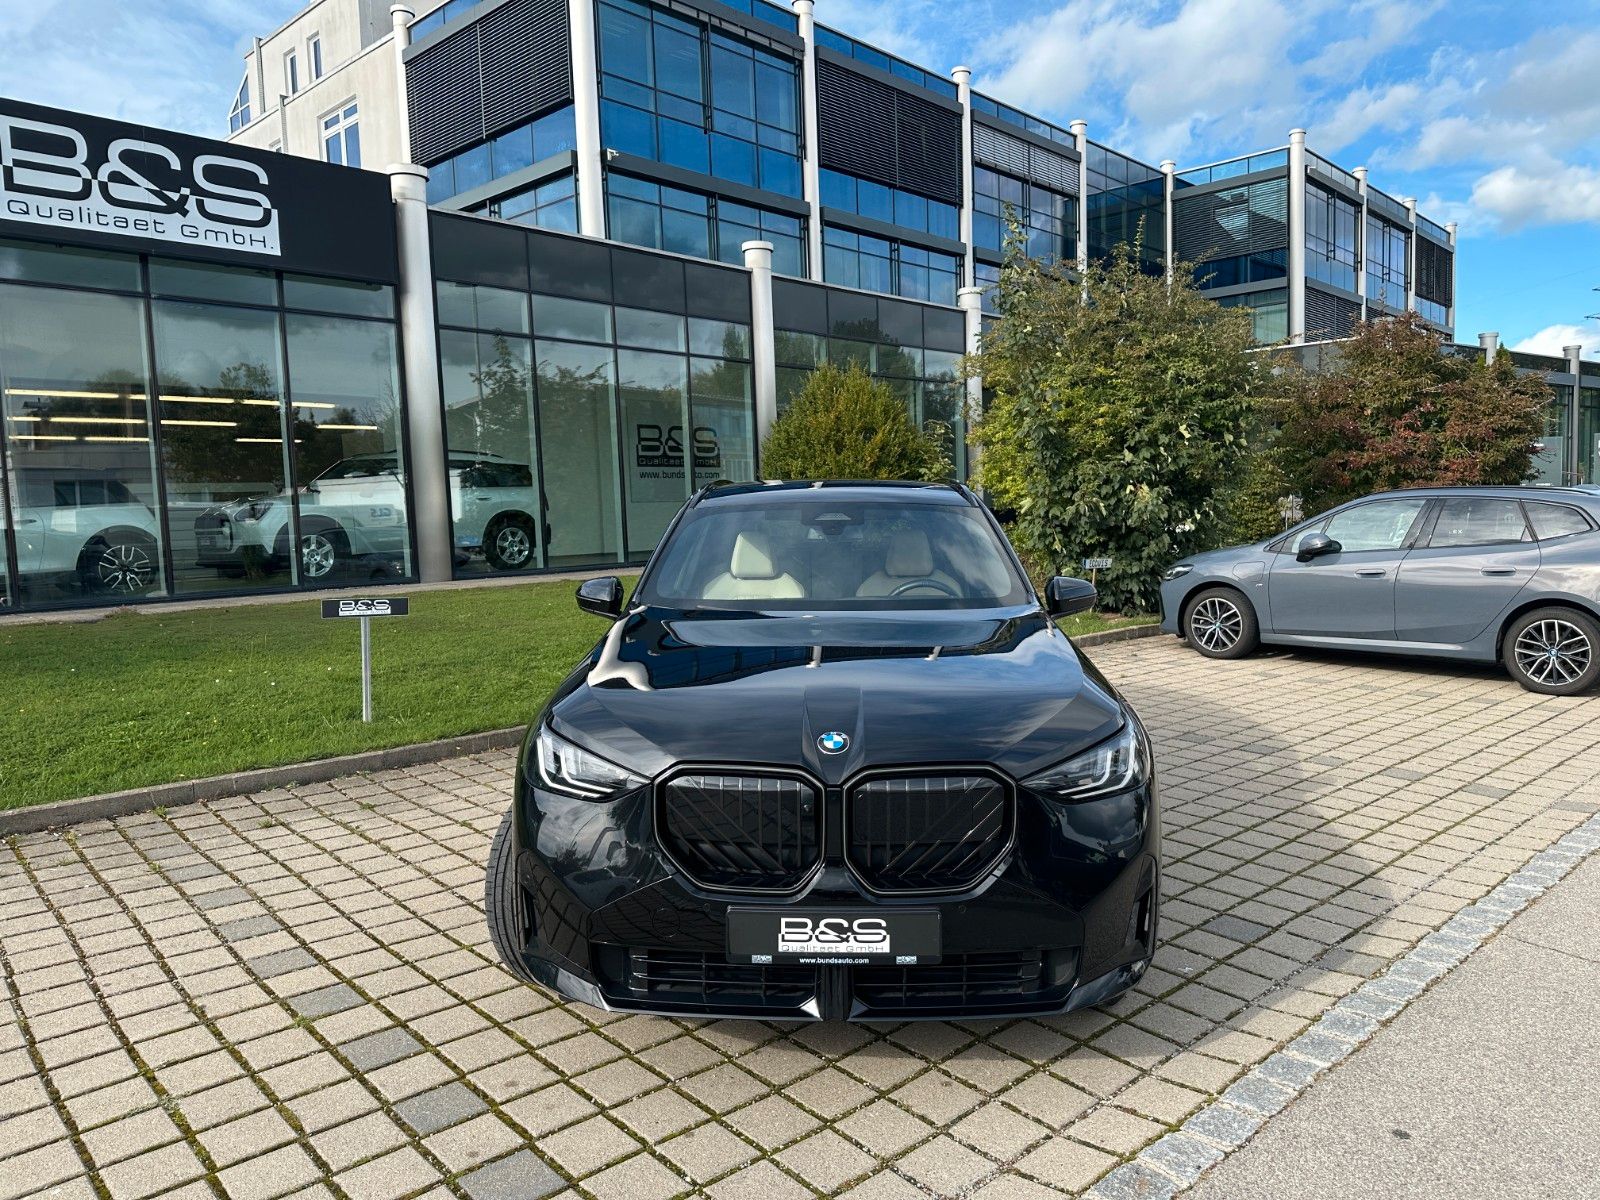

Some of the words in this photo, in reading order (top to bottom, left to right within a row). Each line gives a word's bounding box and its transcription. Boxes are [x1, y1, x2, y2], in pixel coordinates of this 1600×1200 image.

[0, 114, 272, 228] B&S
[7, 200, 166, 234] Qualitaet
[180, 224, 275, 250] GmbH.
[636, 424, 719, 457] B&S
[340, 600, 390, 612] B&S
[780, 917, 887, 944] B&S
[781, 944, 841, 952] Qualitaet
[799, 957, 870, 965] www.bundsauto.com
